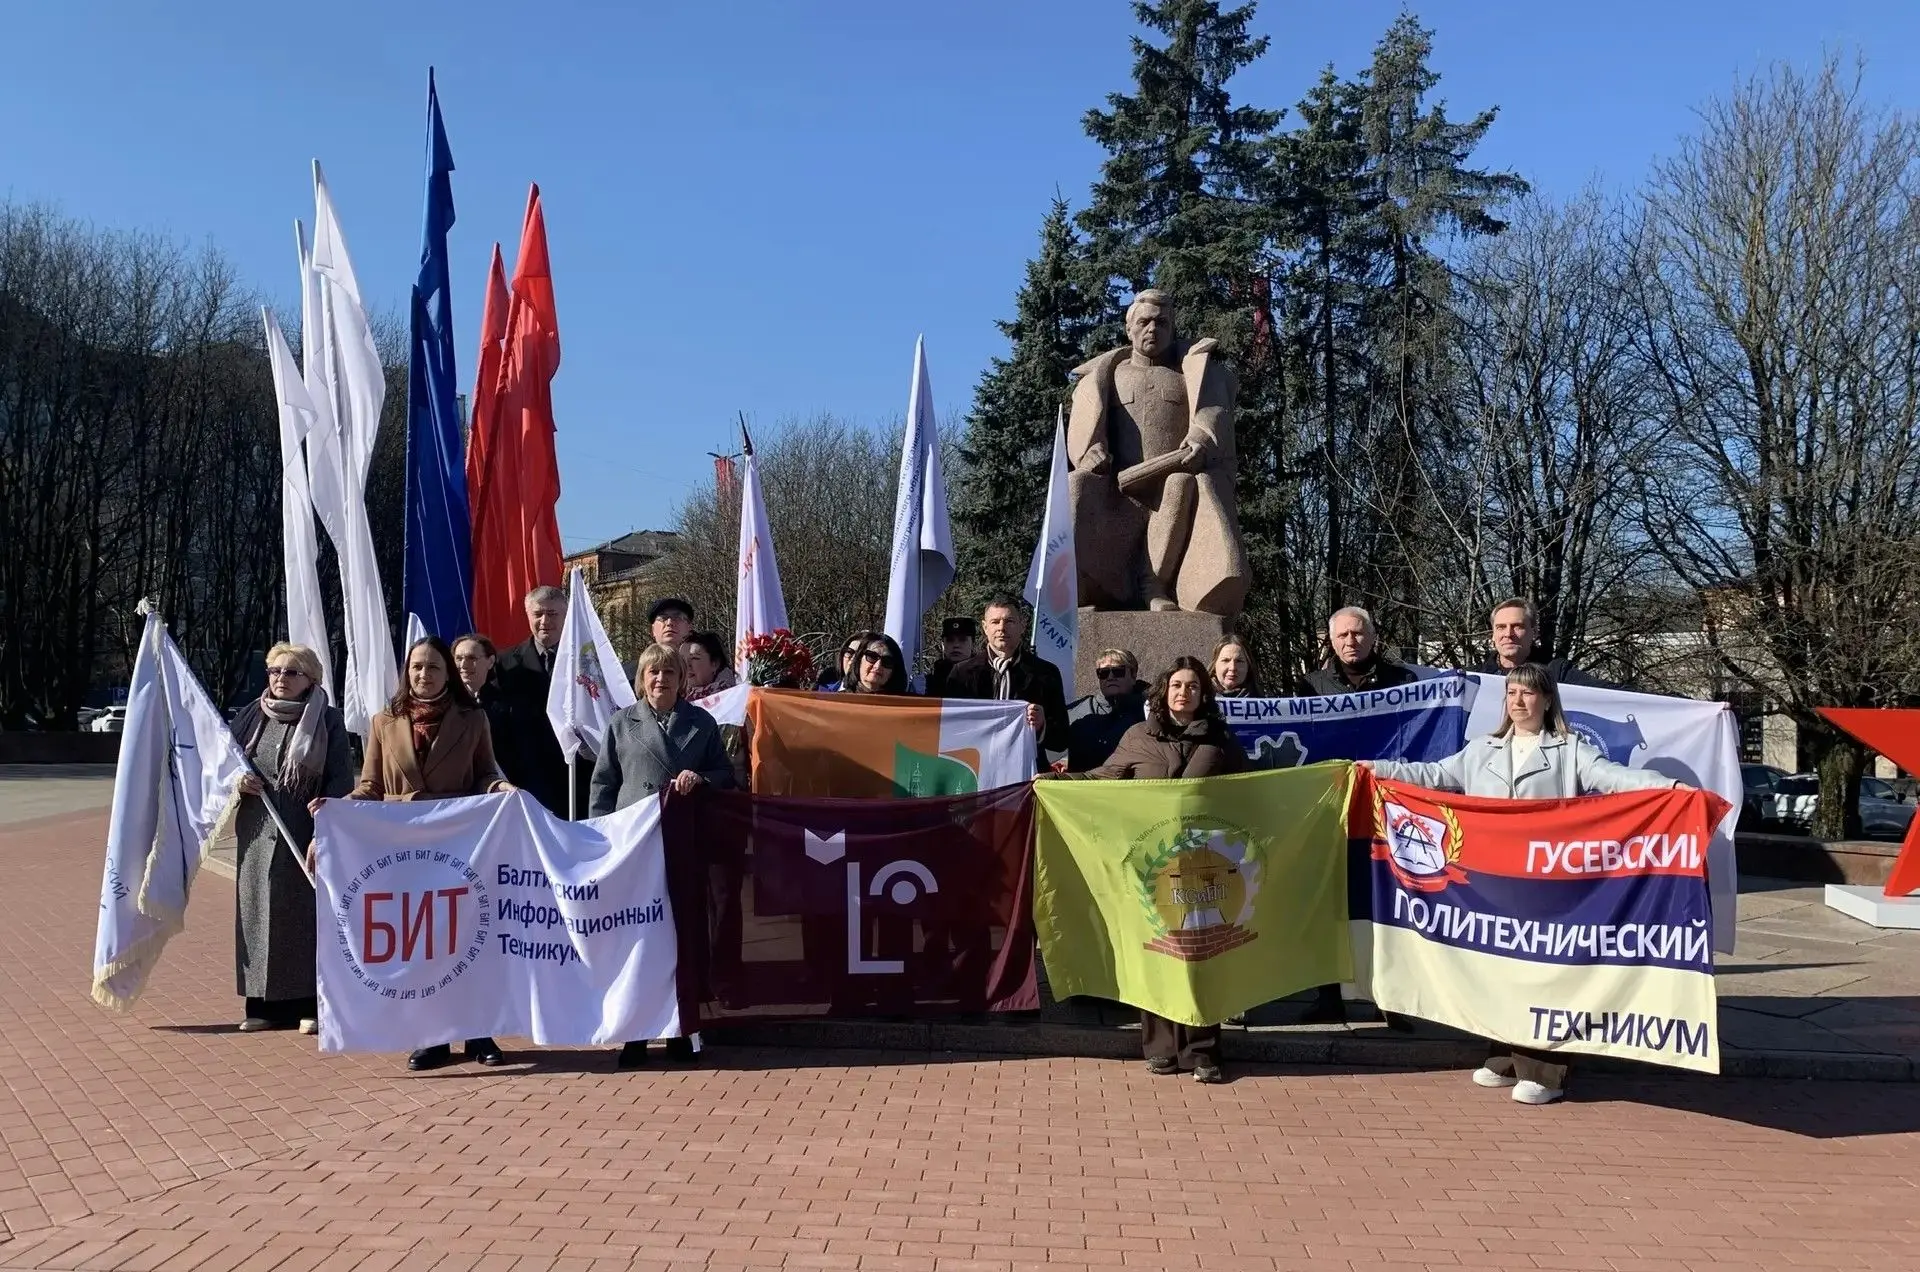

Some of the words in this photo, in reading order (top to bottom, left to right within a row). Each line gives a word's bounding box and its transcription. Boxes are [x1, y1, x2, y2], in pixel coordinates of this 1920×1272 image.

[1289, 680, 1467, 715] МЕХАТРОНИКИ
[376, 855, 392, 869] БИТ
[396, 851, 410, 862] БИТ
[416, 850, 431, 860] БИТ
[434, 852, 450, 863] БИТ
[450, 858, 465, 870] БИТ
[360, 864, 376, 880] БИТ
[462, 867, 478, 882] БИТ
[348, 877, 362, 894] БИТ
[474, 880, 486, 894] БИТ
[497, 864, 599, 900] Балтиский
[340, 894, 352, 910] БИТ
[478, 894, 490, 908] БИТ
[364, 887, 469, 964] БИТ
[480, 912, 490, 927] БИТ
[1394, 888, 1710, 964] ПОЛИТЕХНИЧЕСКИЙ
[474, 930, 488, 944] БИТ
[342, 948, 354, 962] БИТ
[466, 946, 480, 962] БИТ
[350, 964, 364, 978] БИТ
[452, 961, 468, 976] БИТ
[363, 978, 380, 992] БИТ
[438, 974, 452, 989] БИТ
[380, 986, 397, 998] БИТ
[400, 989, 416, 1000] БИТ
[421, 986, 436, 998] БИТ
[1529, 1006, 1708, 1057] ТЕХНИКУМ
